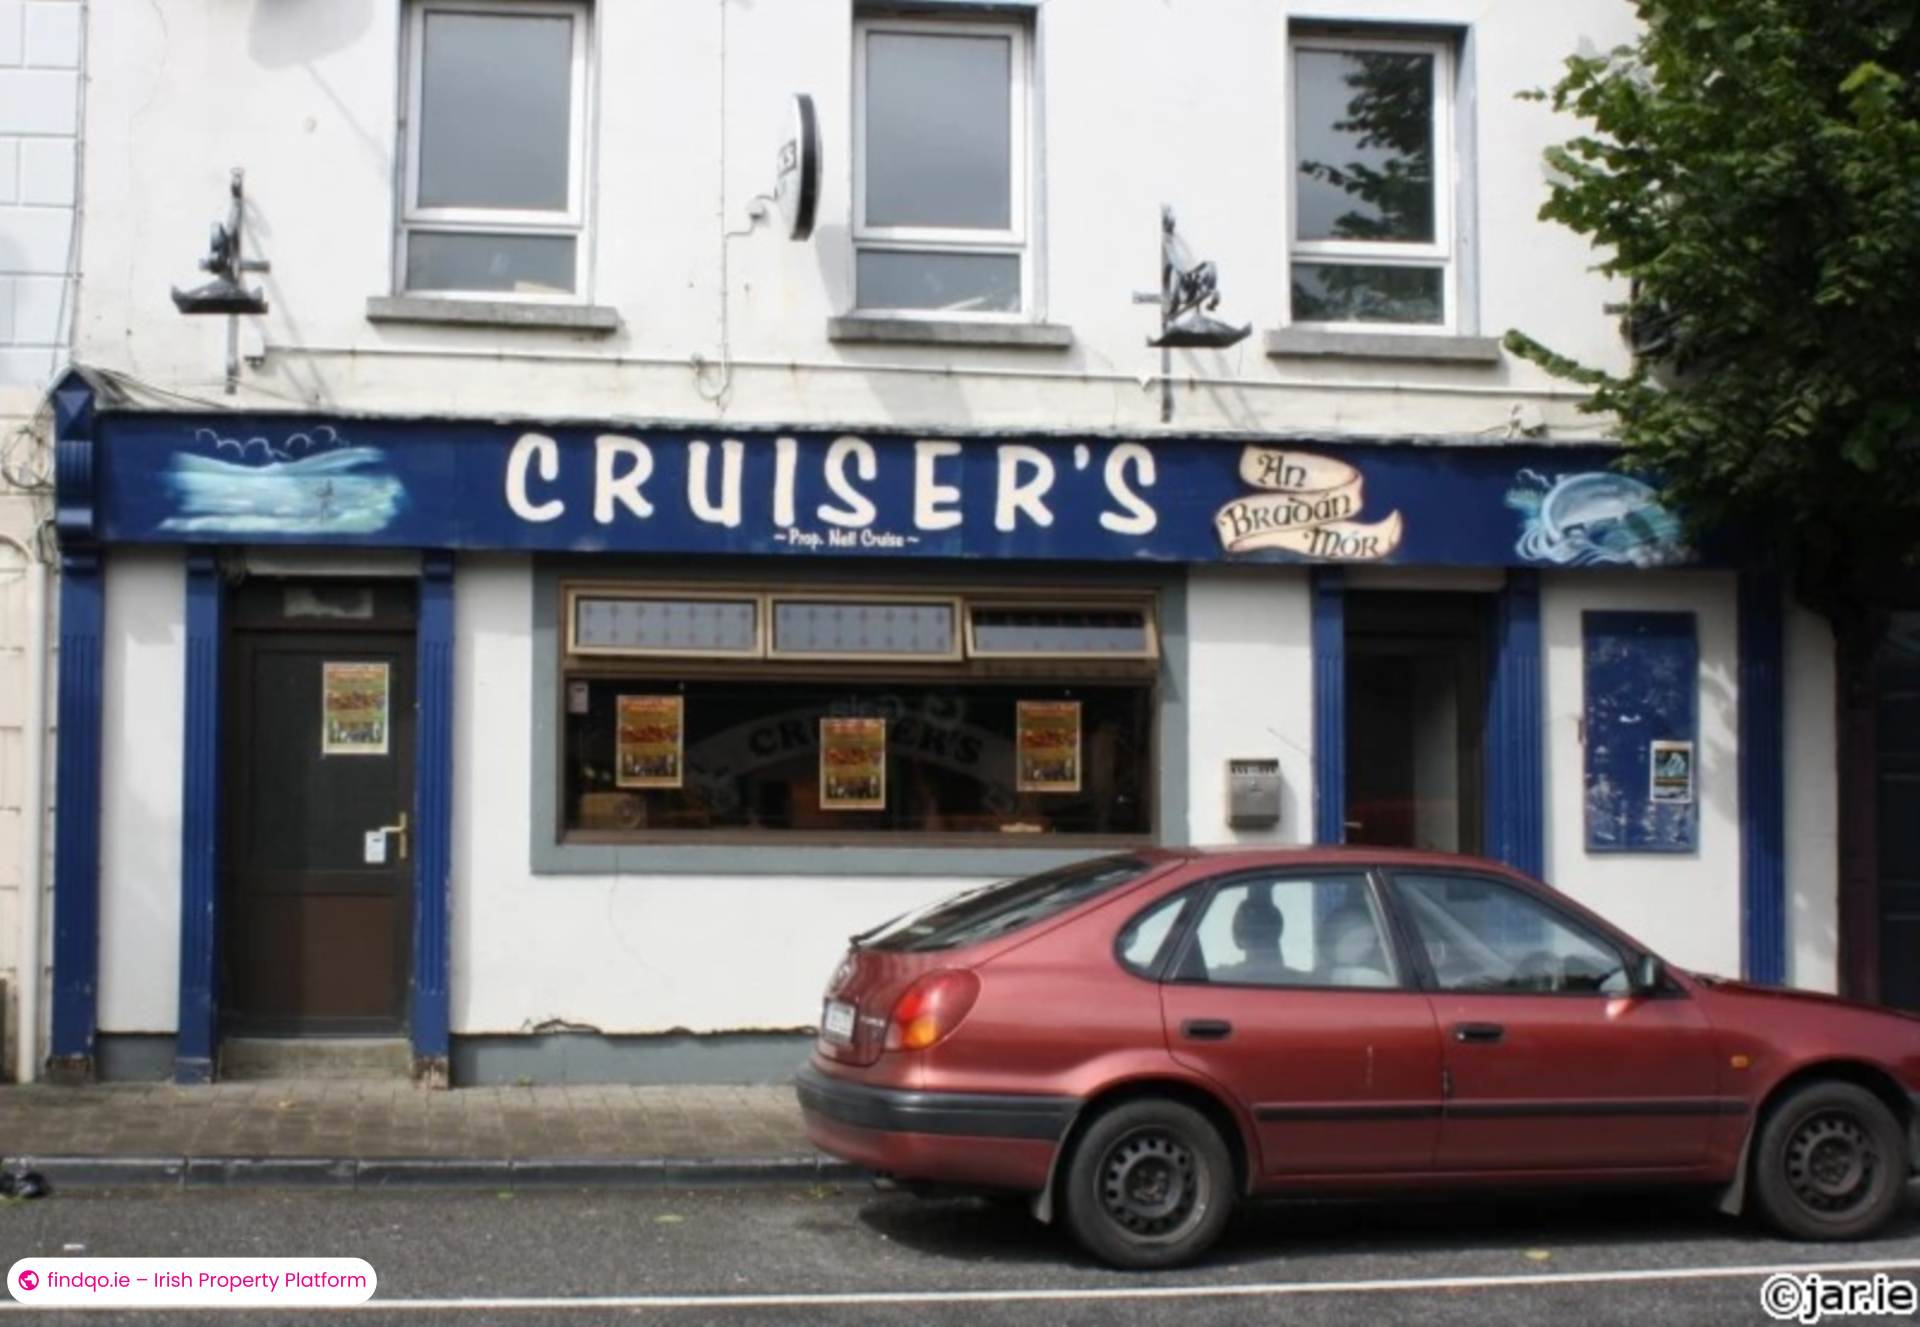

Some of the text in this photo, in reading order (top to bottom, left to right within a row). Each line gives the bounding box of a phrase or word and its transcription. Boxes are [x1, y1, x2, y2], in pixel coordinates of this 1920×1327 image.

[505, 433, 1158, 535] CRUISER'S
[1257, 453, 1307, 487] An
[747, 717, 984, 765] CRER'S
